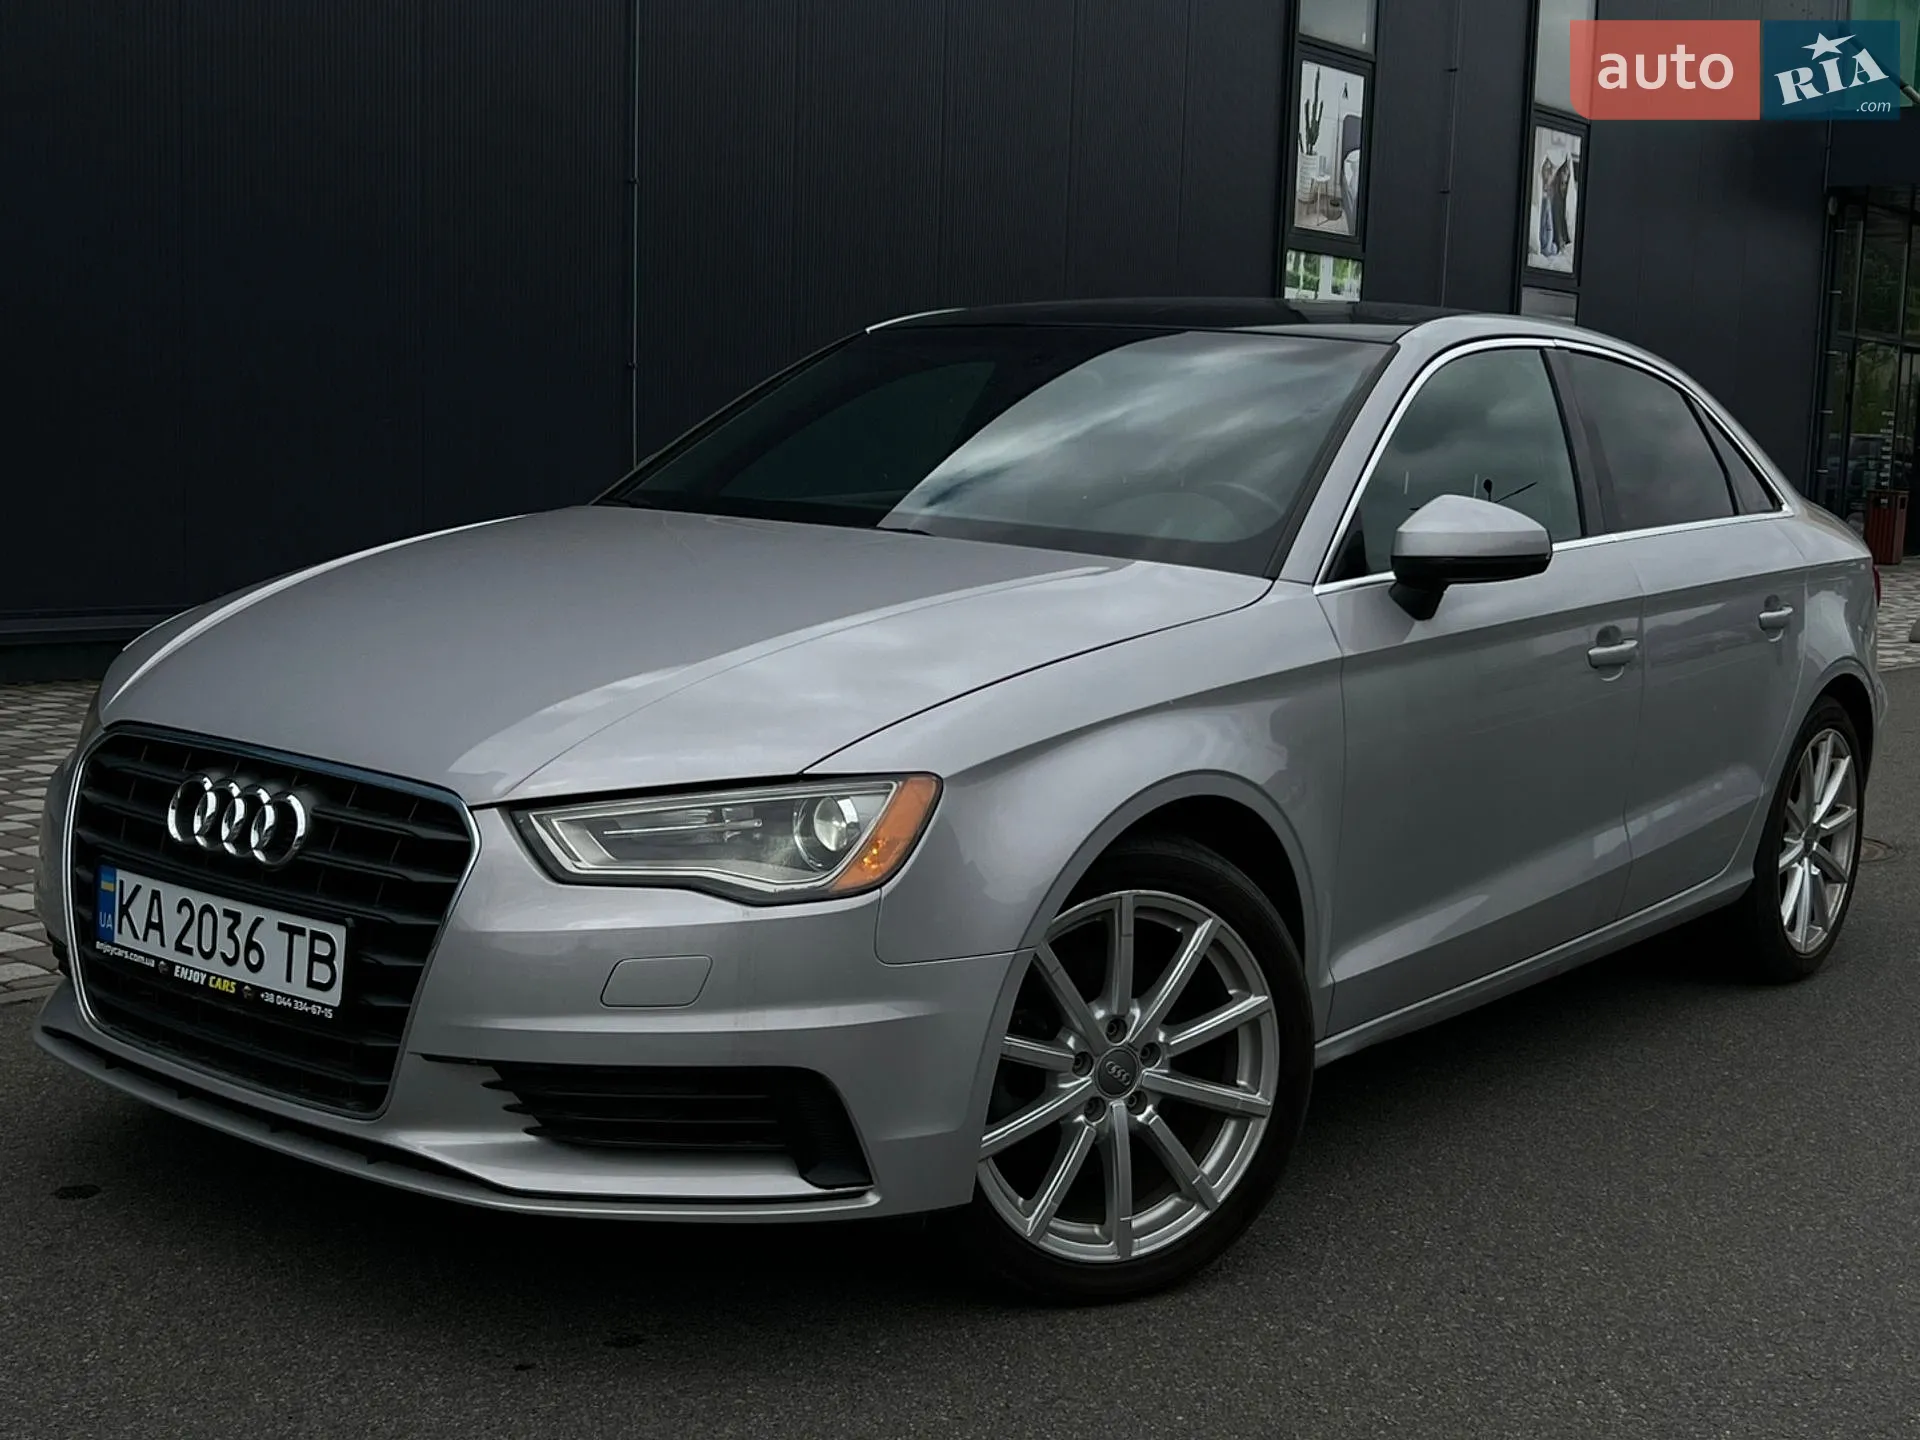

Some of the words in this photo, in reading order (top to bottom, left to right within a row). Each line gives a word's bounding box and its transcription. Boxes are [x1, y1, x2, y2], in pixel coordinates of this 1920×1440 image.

[99, 911, 114, 930] UA
[117, 879, 166, 948] KA
[174, 898, 265, 974] 2036
[277, 921, 337, 992] TB
[173, 965, 207, 985] ENJOY
[208, 975, 236, 994] CARS
[260, 992, 275, 1004] +38
